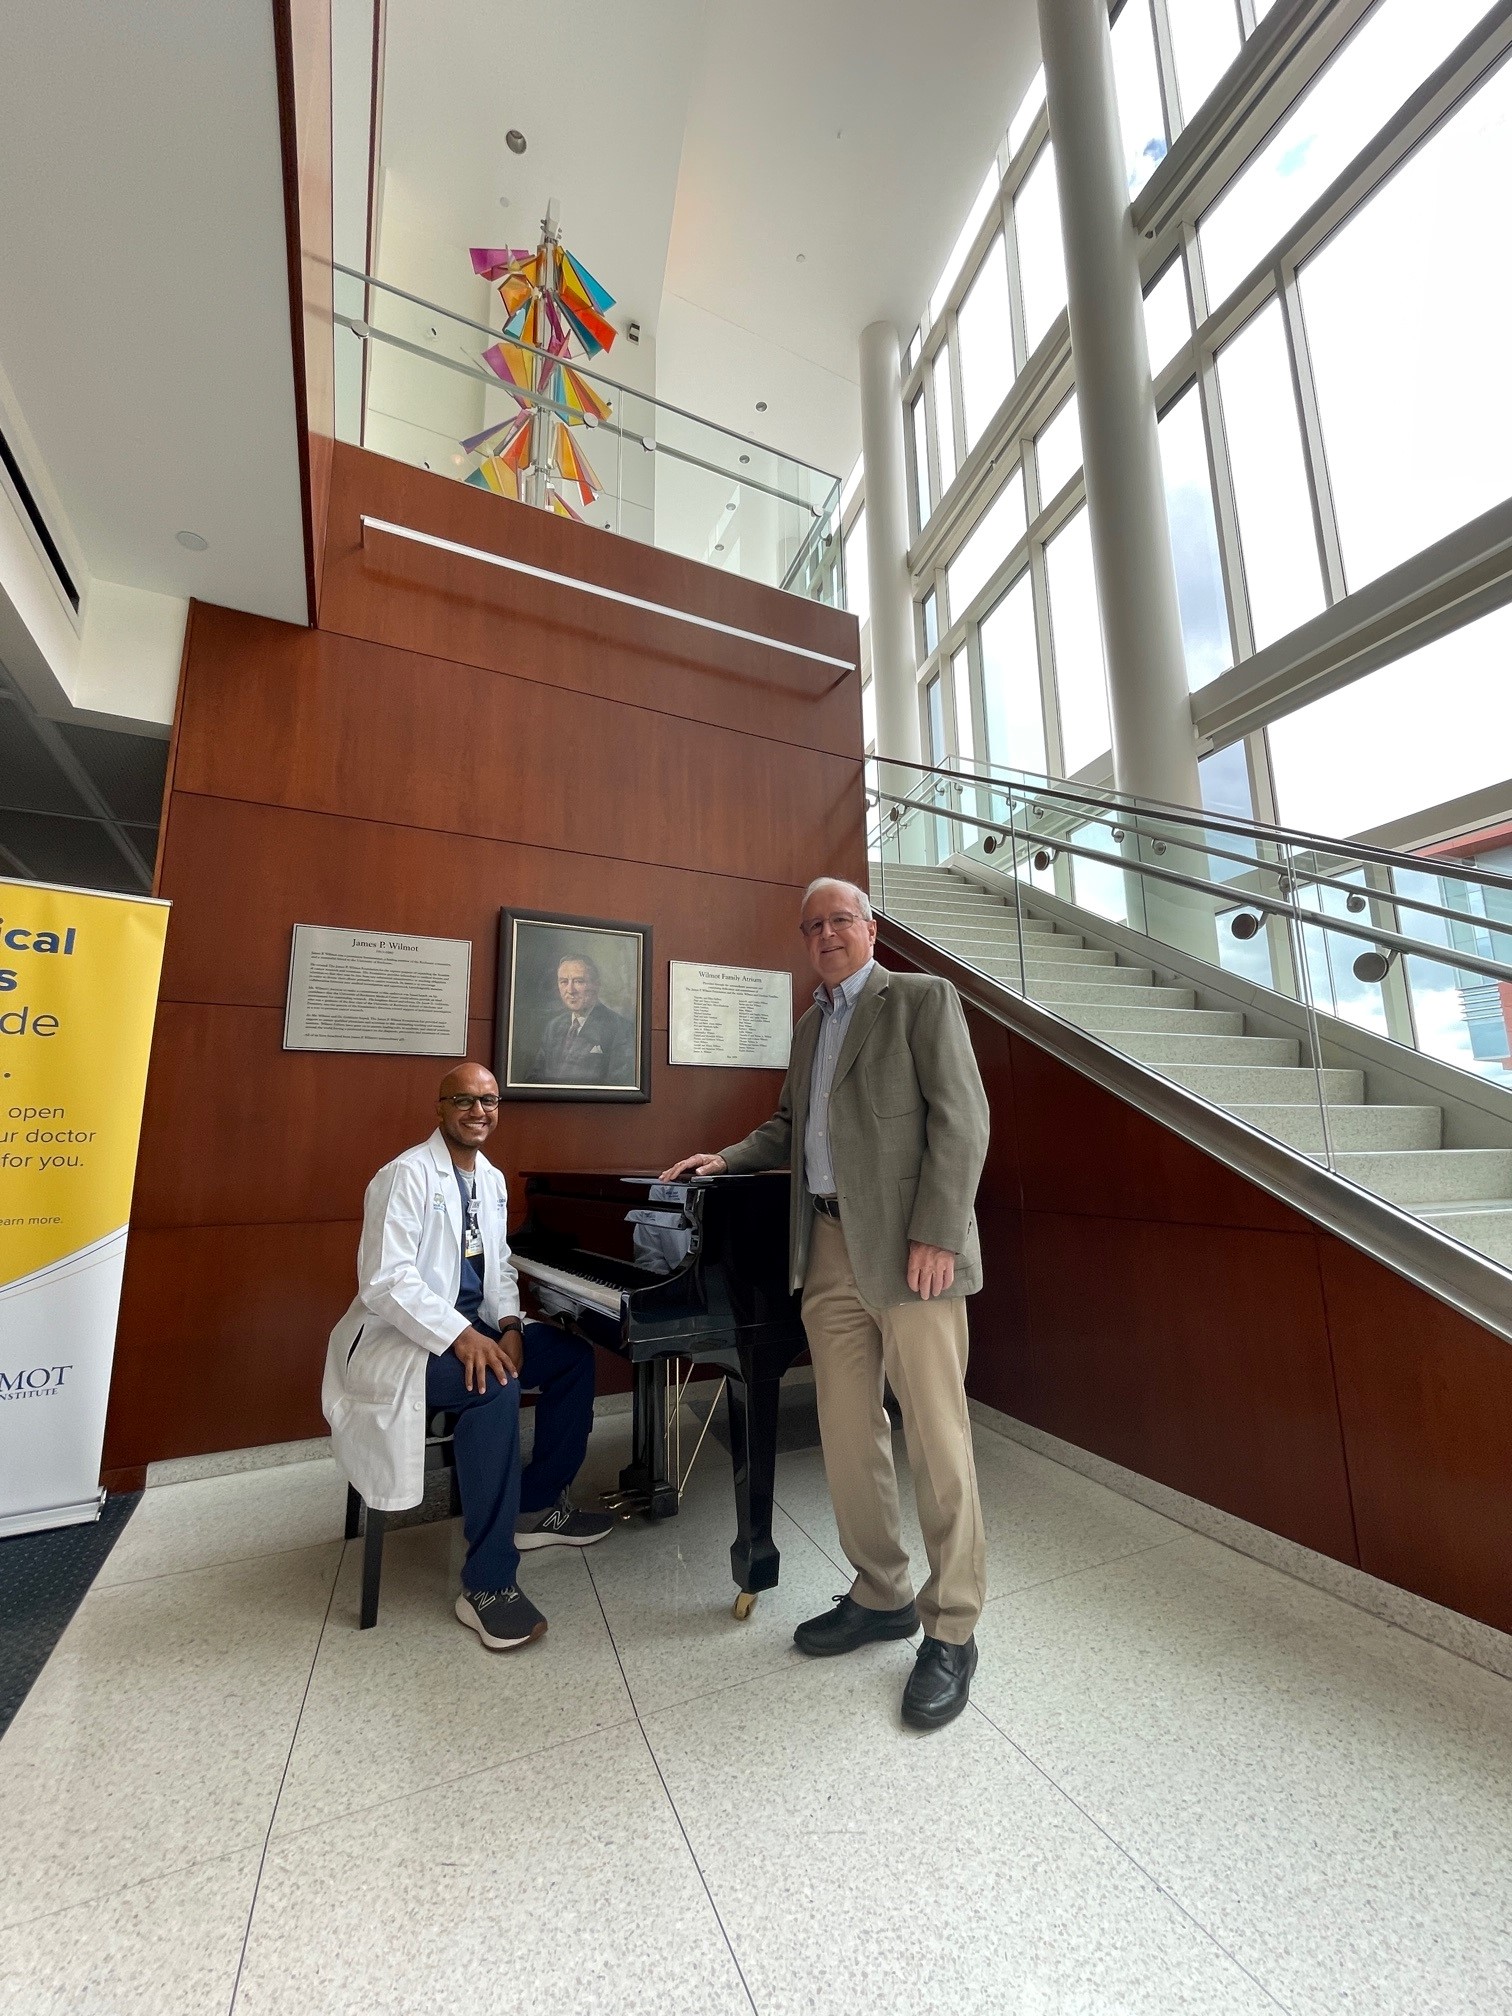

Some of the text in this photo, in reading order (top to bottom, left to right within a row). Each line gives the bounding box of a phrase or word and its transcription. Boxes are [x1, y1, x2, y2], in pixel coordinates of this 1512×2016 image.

[0, 917, 76, 955] cal
[352, 938, 377, 948] James
[389, 942, 419, 952] Wilmot
[699, 971, 721, 980] Wilmot
[721, 973, 741, 982] Family
[8, 1107, 65, 1121] open
[25, 1128, 97, 1143] doctor
[2, 1153, 84, 1171] for you.
[28, 1216, 63, 1225] more.
